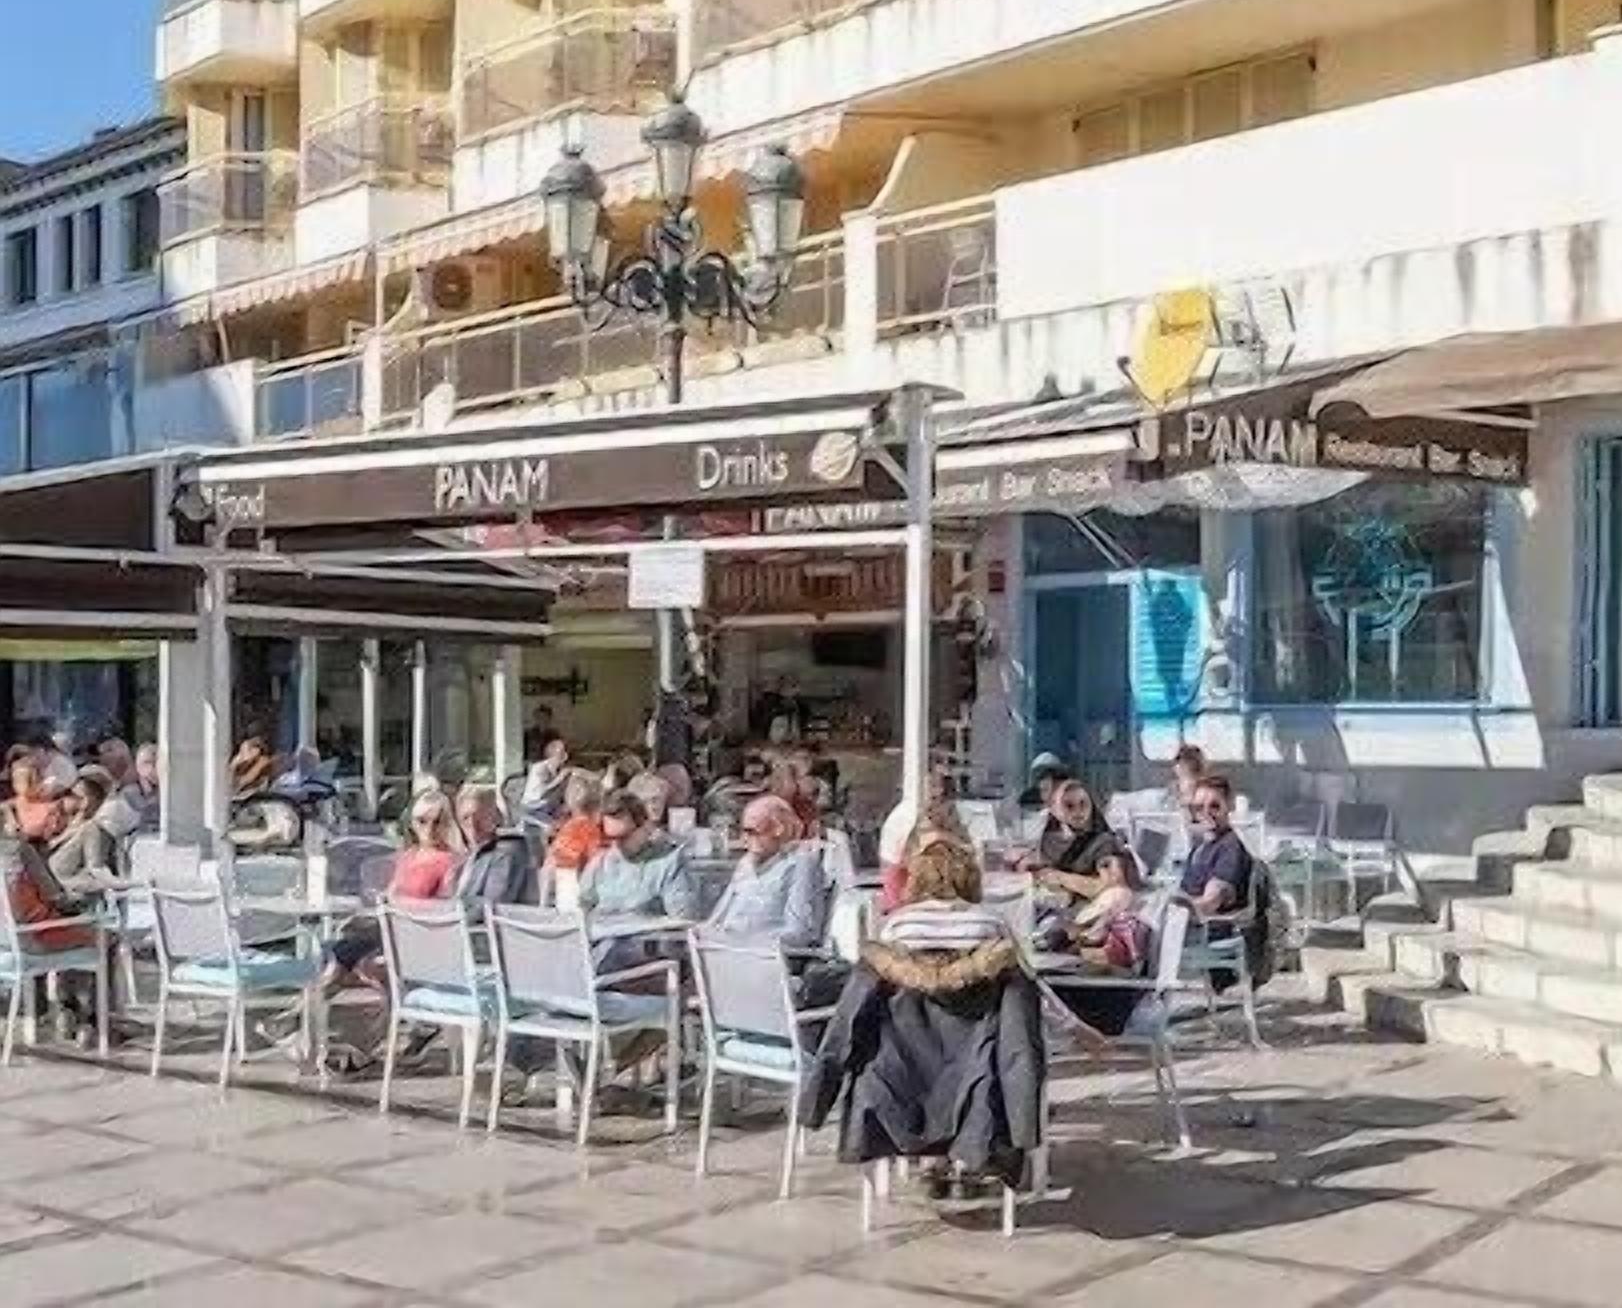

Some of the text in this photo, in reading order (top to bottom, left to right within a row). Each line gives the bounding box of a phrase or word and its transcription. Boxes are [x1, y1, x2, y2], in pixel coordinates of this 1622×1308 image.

[1185, 410, 1318, 470] PANAM
[214, 440, 789, 521] Food PANAM Drinks
